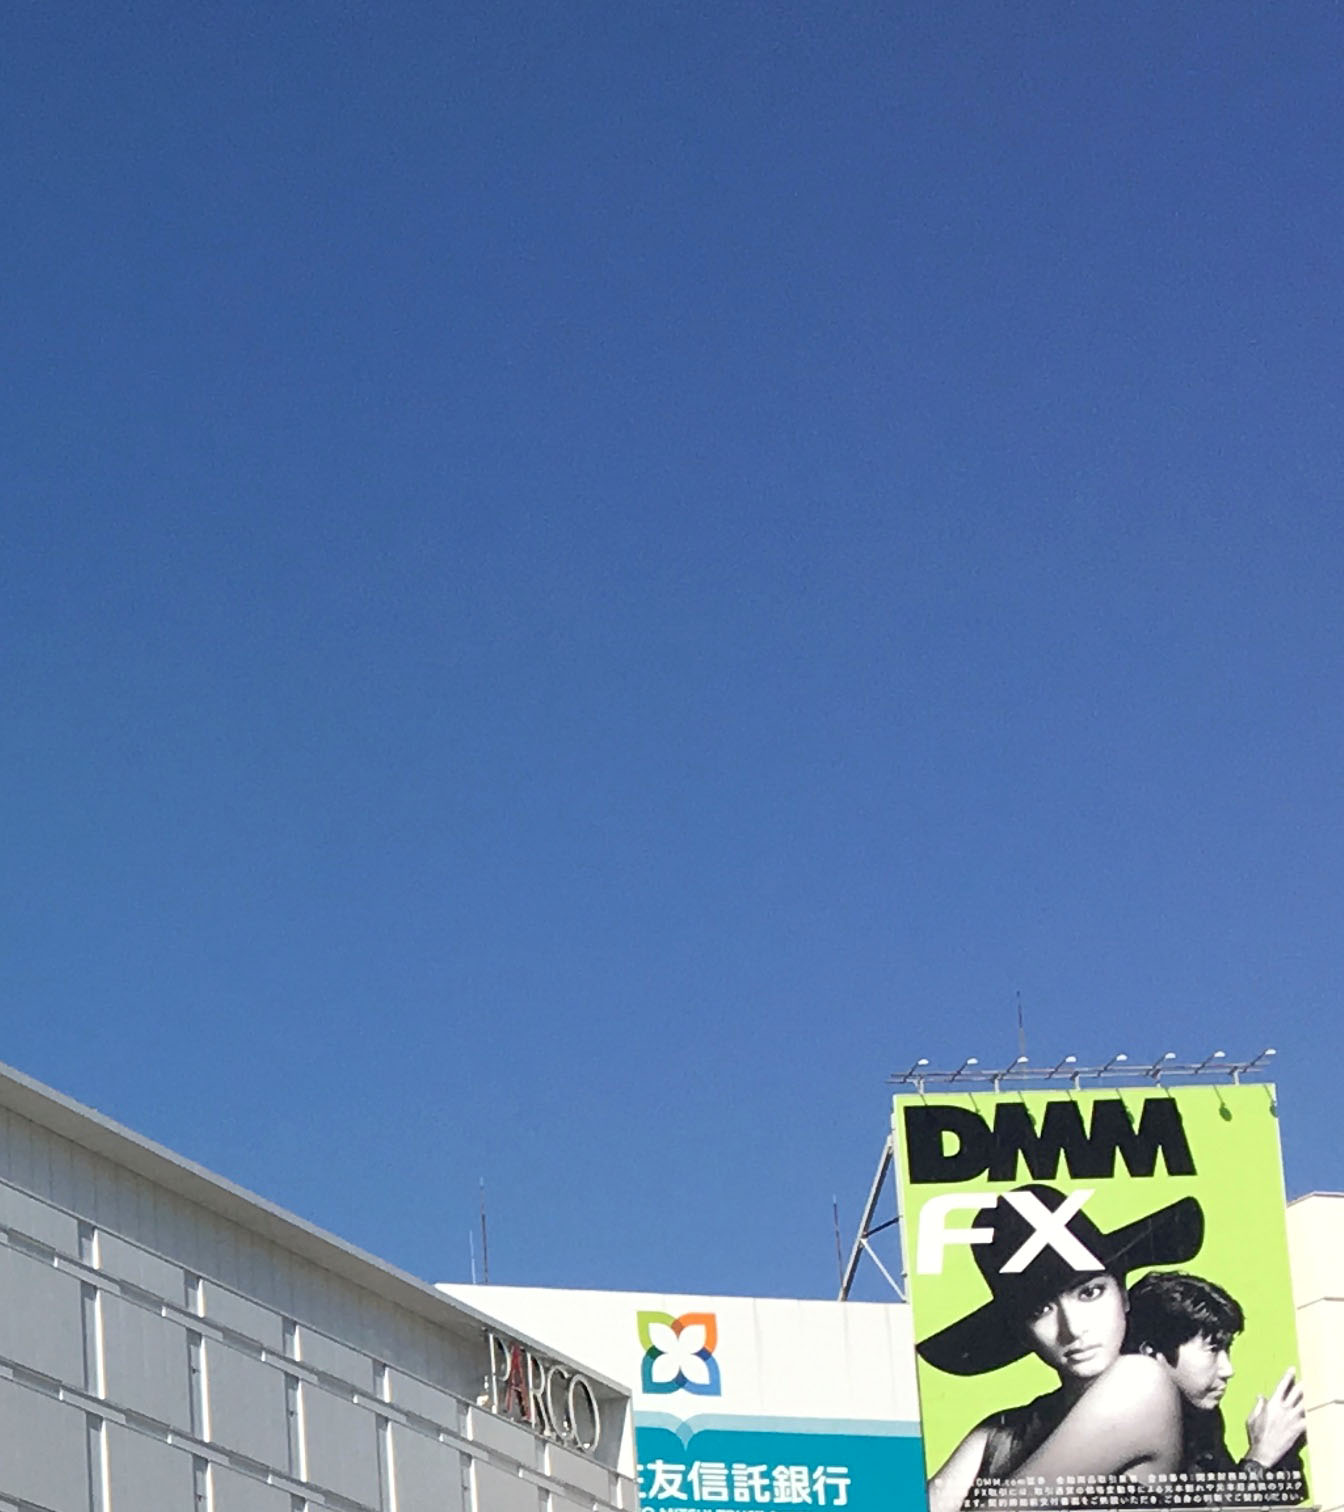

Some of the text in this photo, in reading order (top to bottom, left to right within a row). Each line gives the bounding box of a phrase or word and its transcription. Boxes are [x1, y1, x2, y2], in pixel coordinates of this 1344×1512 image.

[904, 1097, 1196, 1184] DMM
[916, 1188, 1104, 1275] FX
[486, 1329, 601, 1452] PARCO
[638, 1460, 851, 1506] 友信託銀行
